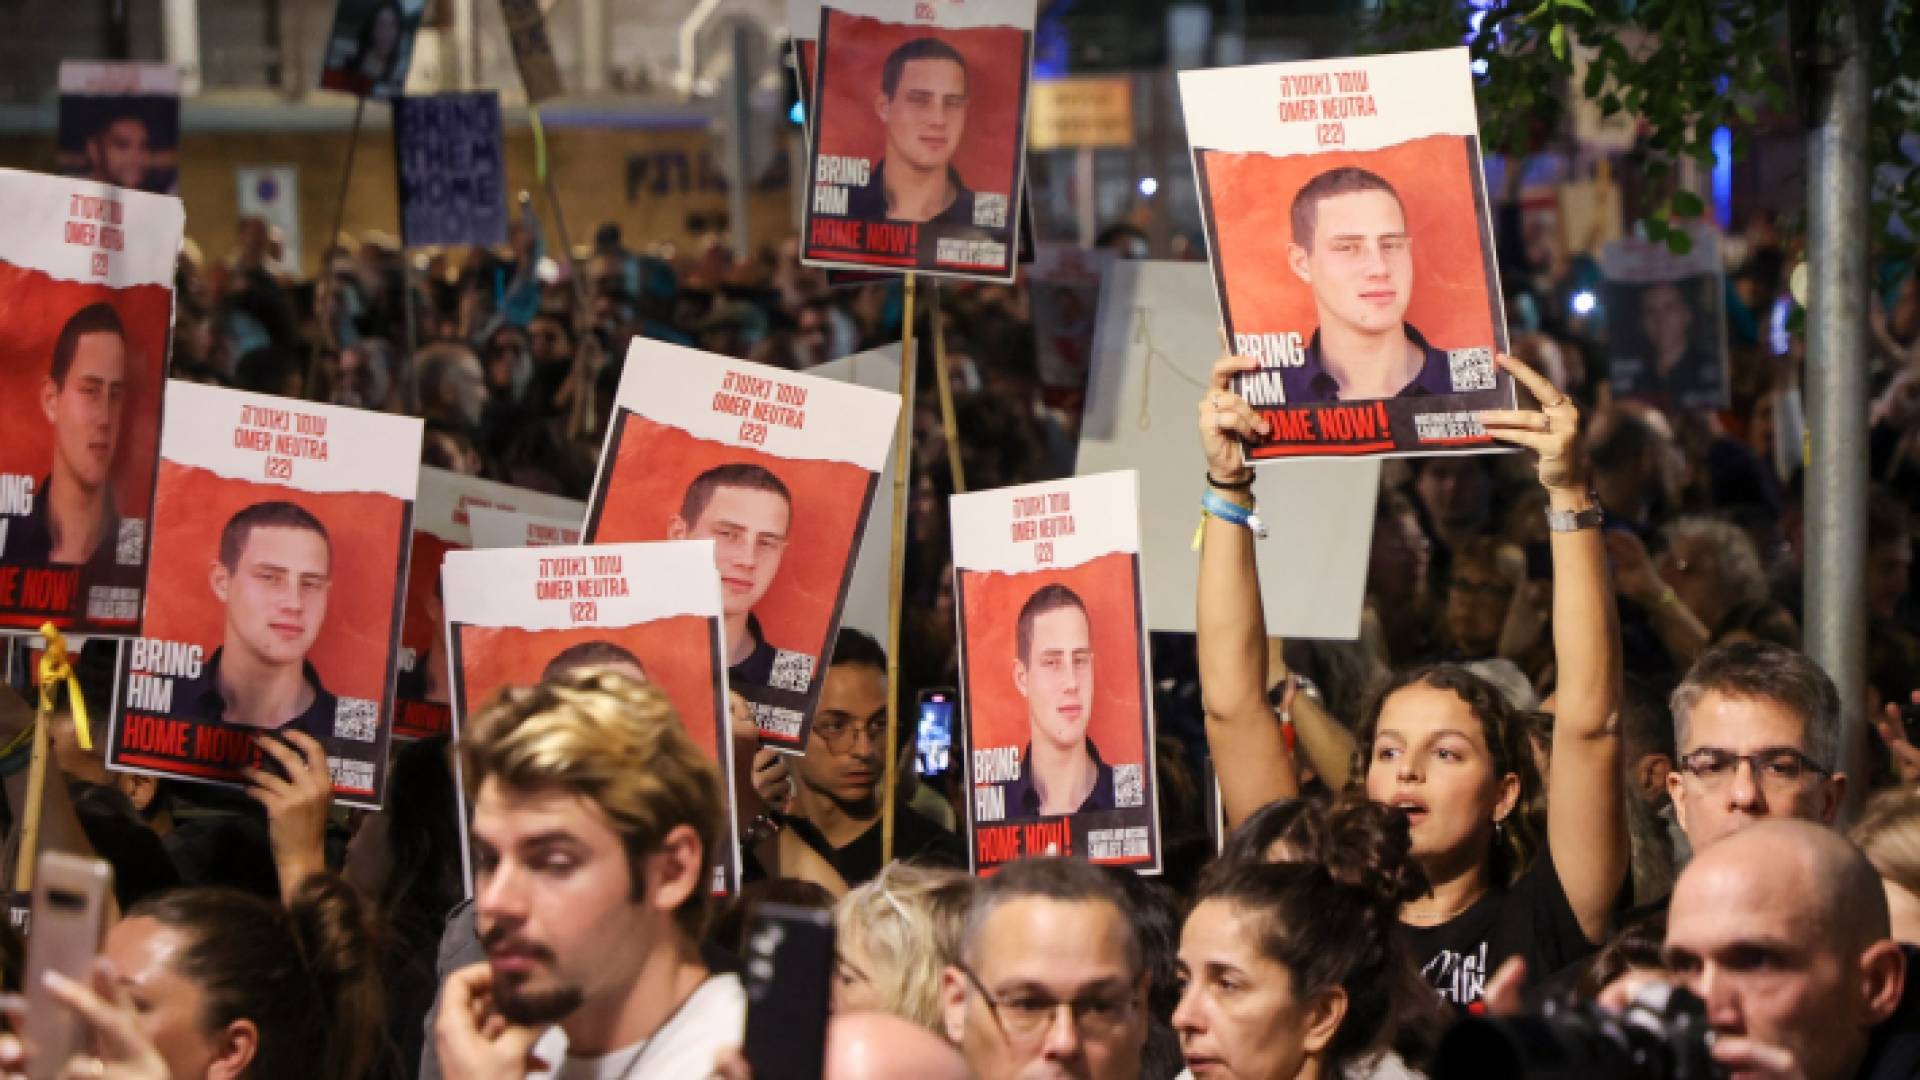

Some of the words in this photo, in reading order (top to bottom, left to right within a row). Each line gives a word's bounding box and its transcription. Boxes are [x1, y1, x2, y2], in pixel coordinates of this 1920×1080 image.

[1279, 99, 1318, 122] OMER
[1322, 94, 1377, 119] NEUTRA
[1316, 121, 1345, 146] (22)
[816, 154, 870, 187] BRING
[813, 186, 848, 216] HIM
[811, 218, 864, 249] HOME
[866, 223, 918, 256] NOW!
[713, 389, 751, 417] OMER
[753, 401, 805, 431] NEUTRA
[1263, 409, 1316, 442] OME
[1317, 402, 1391, 440] NOW!
[234, 426, 272, 451] OMER
[275, 434, 328, 462] NEUTRA
[738, 421, 767, 446] (22)
[264, 456, 293, 480] (22)
[0, 472, 35, 515] ING
[1011, 519, 1038, 543] OMER
[1039, 514, 1076, 538] NEUTRA
[535, 579, 573, 601] OMER
[577, 577, 630, 598] NEUTRA
[569, 600, 598, 623] (22)
[130, 636, 204, 679] BRING
[126, 675, 174, 714] HIM
[121, 713, 192, 758] HOME
[974, 745, 1021, 784] BRING
[975, 783, 1006, 822] HIM
[976, 825, 1022, 864] HOME
[1024, 815, 1073, 858] NOW!
